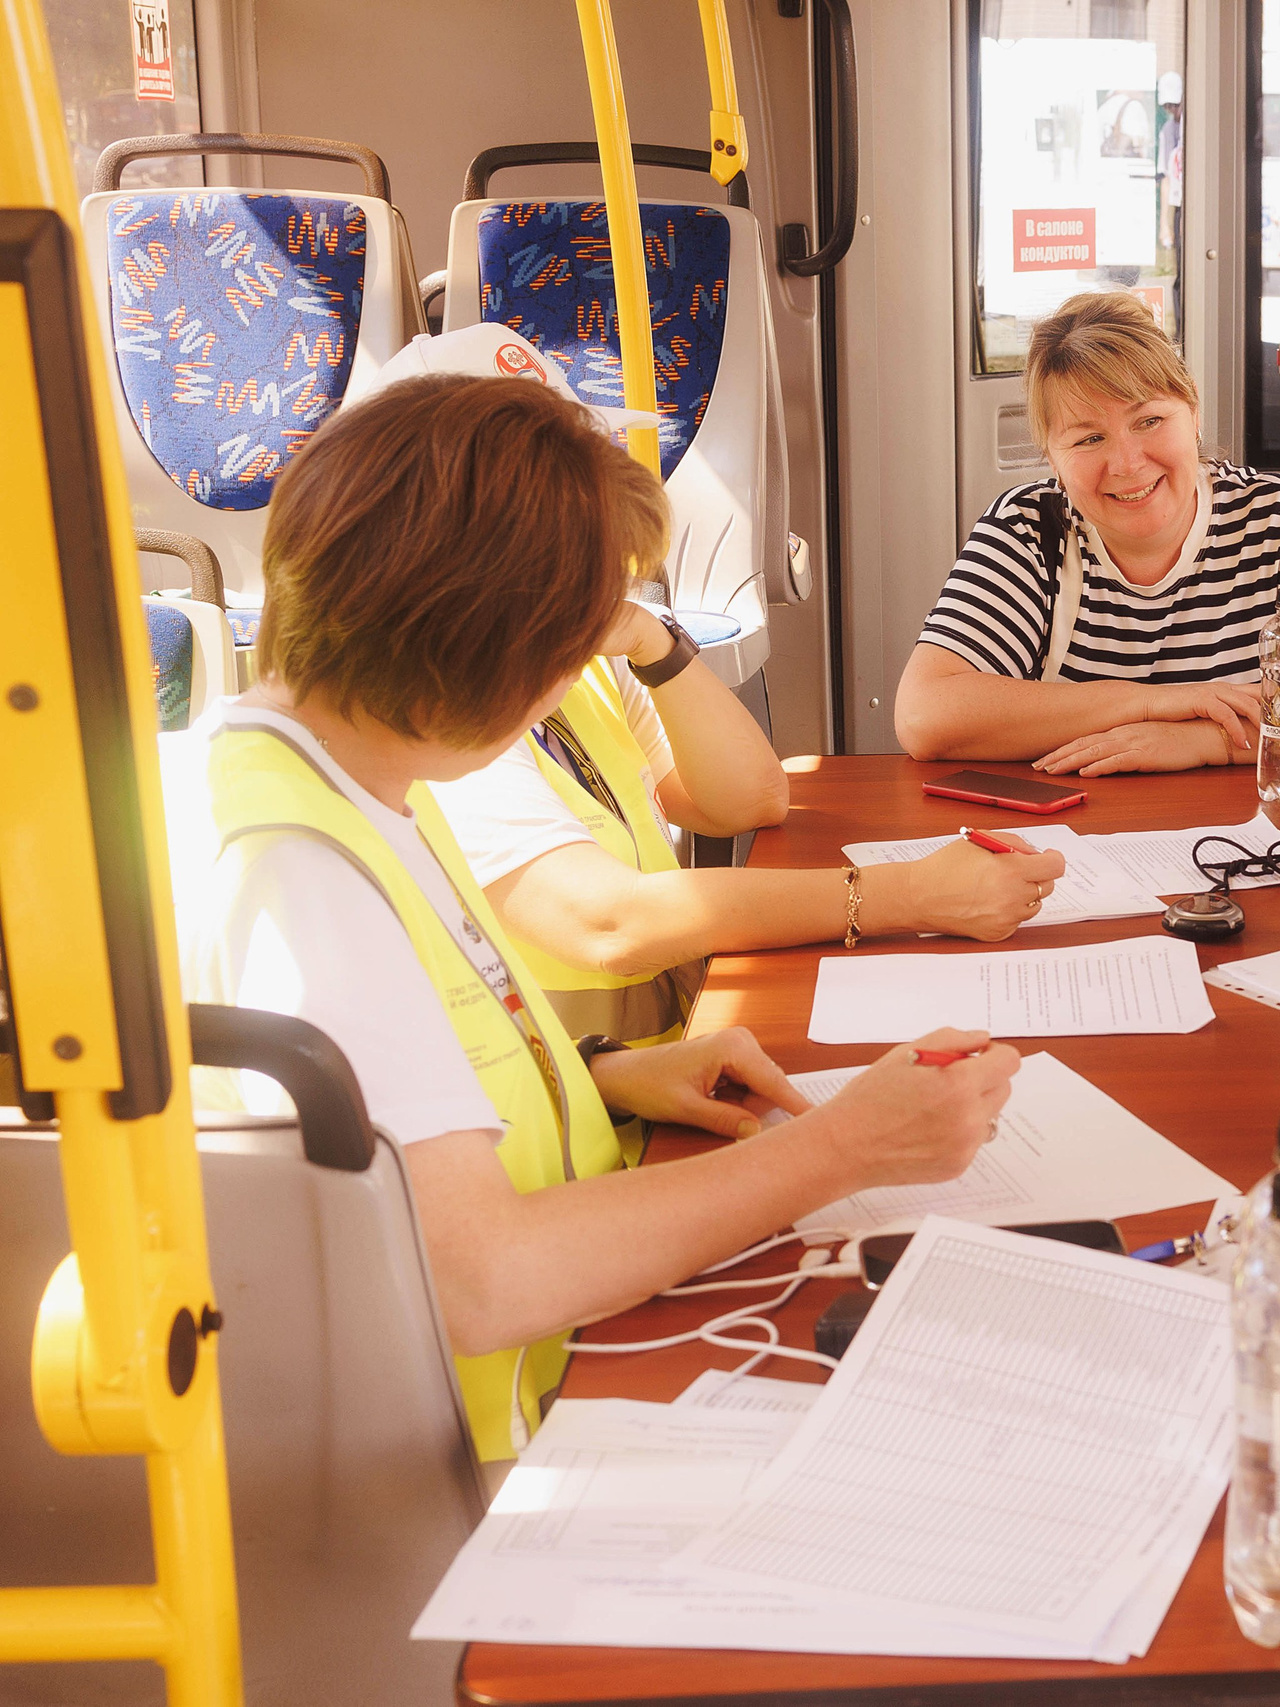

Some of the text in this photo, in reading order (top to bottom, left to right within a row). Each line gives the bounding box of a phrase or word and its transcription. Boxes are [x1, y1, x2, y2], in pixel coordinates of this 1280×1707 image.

[1025, 219, 1084, 238] В салоне
[1020, 244, 1090, 264] кондуктор
